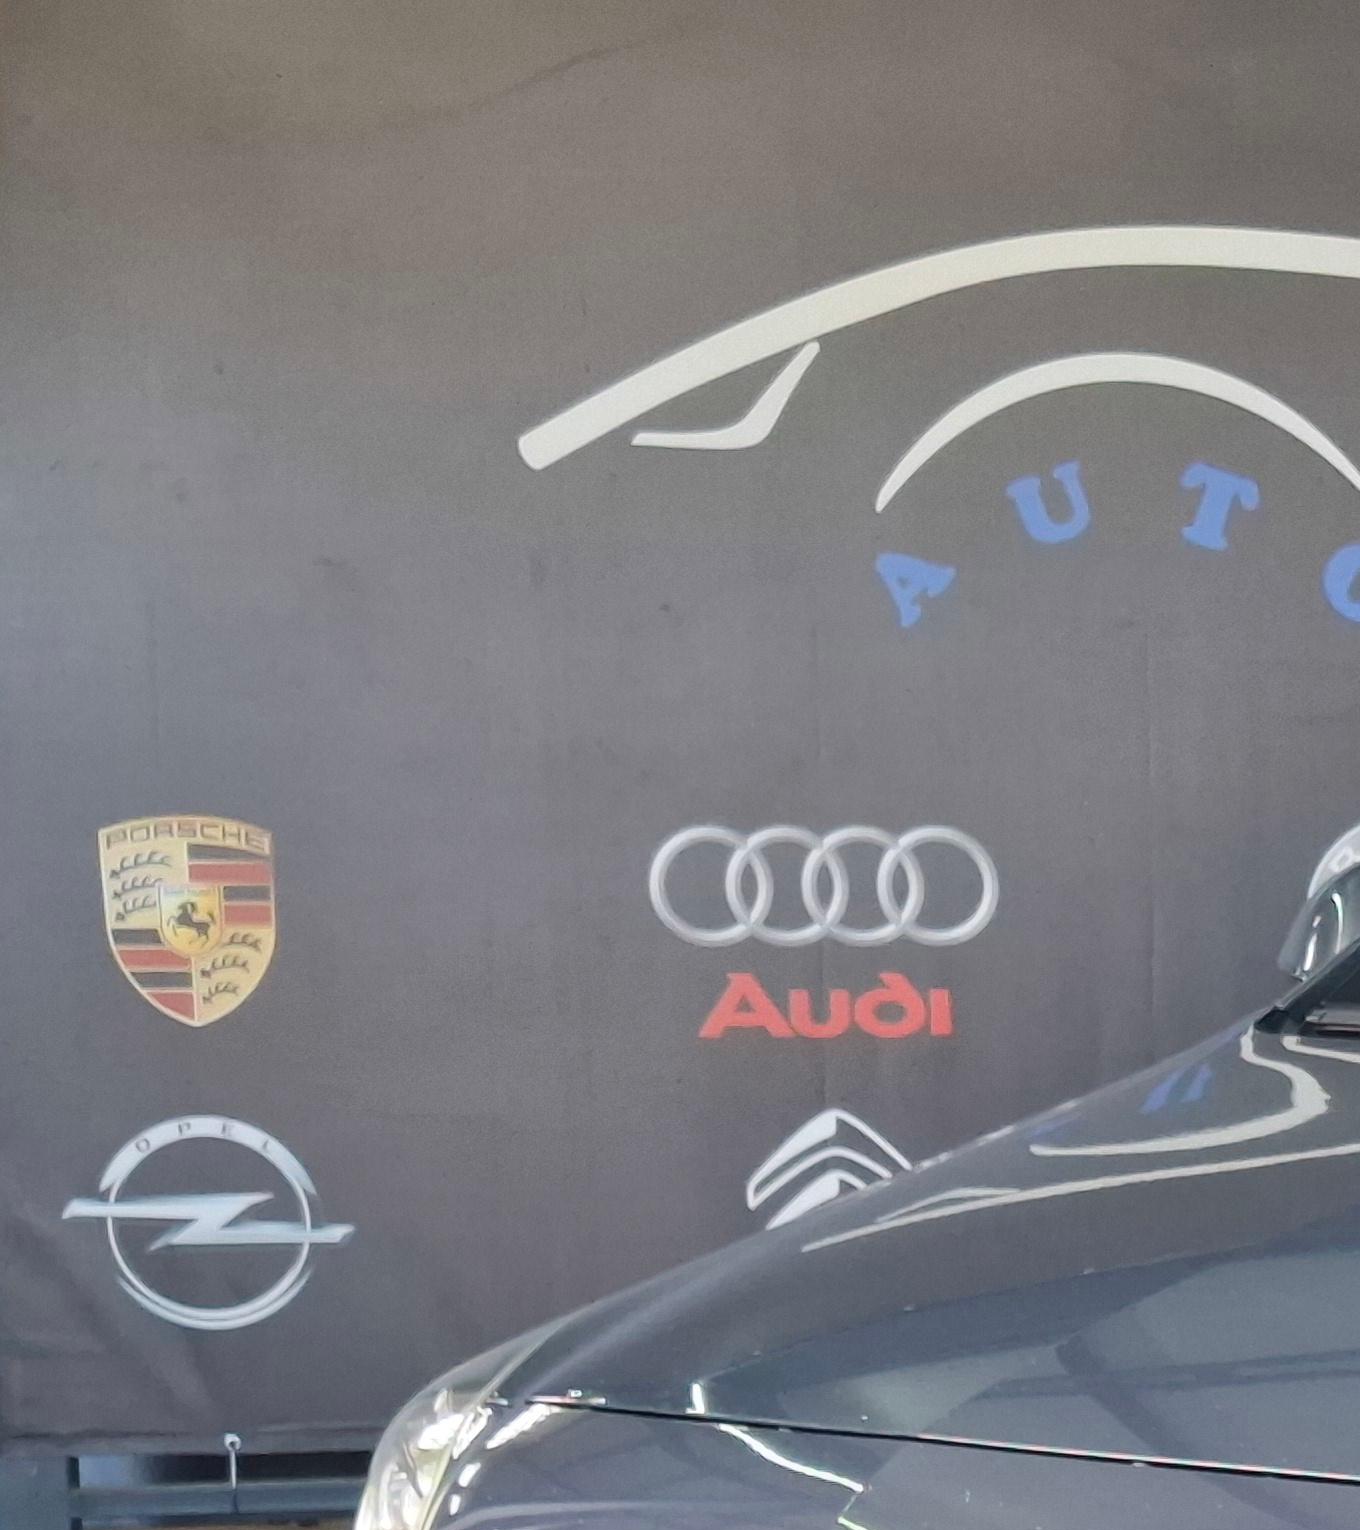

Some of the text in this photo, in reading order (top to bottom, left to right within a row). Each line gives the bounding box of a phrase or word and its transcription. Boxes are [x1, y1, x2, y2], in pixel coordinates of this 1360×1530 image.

[105, 822, 270, 855] PORSCHE
[699, 972, 953, 1039] Audi
[135, 1121, 271, 1153] OPEL
